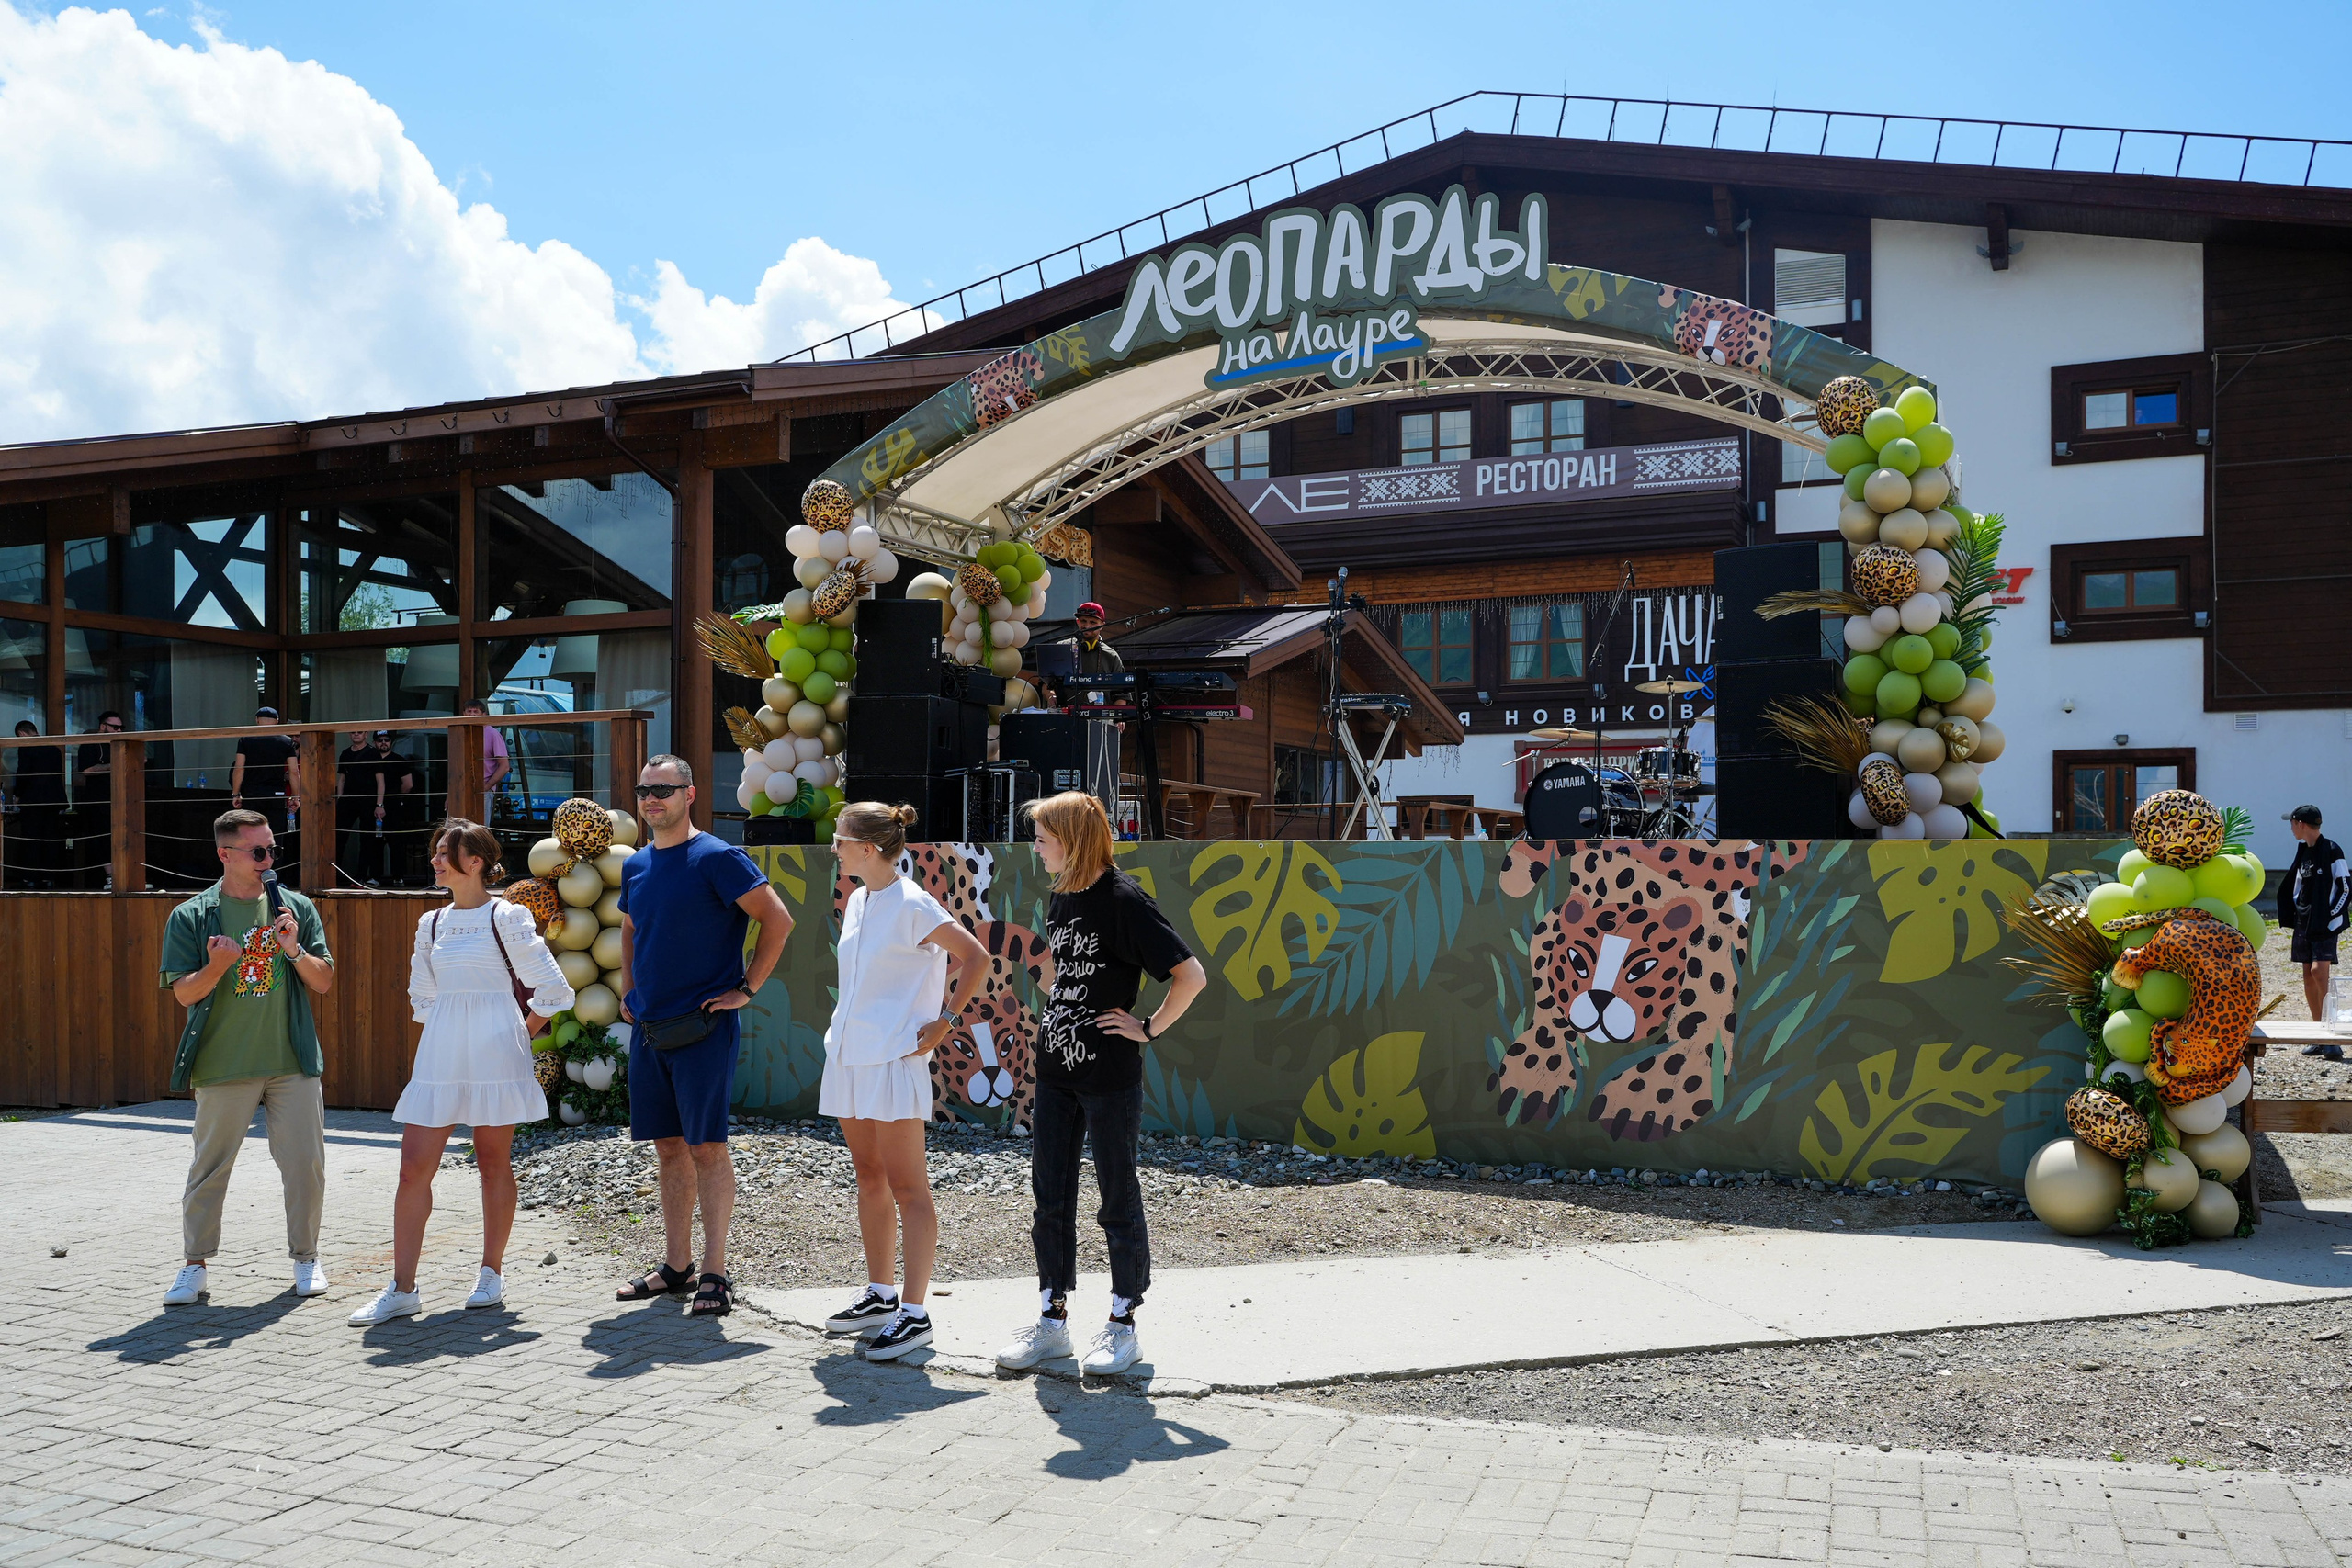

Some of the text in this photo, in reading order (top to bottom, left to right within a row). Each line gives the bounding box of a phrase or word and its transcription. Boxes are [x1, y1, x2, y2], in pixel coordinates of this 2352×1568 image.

[1221, 310, 1416, 379] на Лауре
[1476, 453, 1617, 496] РЕСТОРАН
[1553, 775, 1587, 790] YAMAHA
